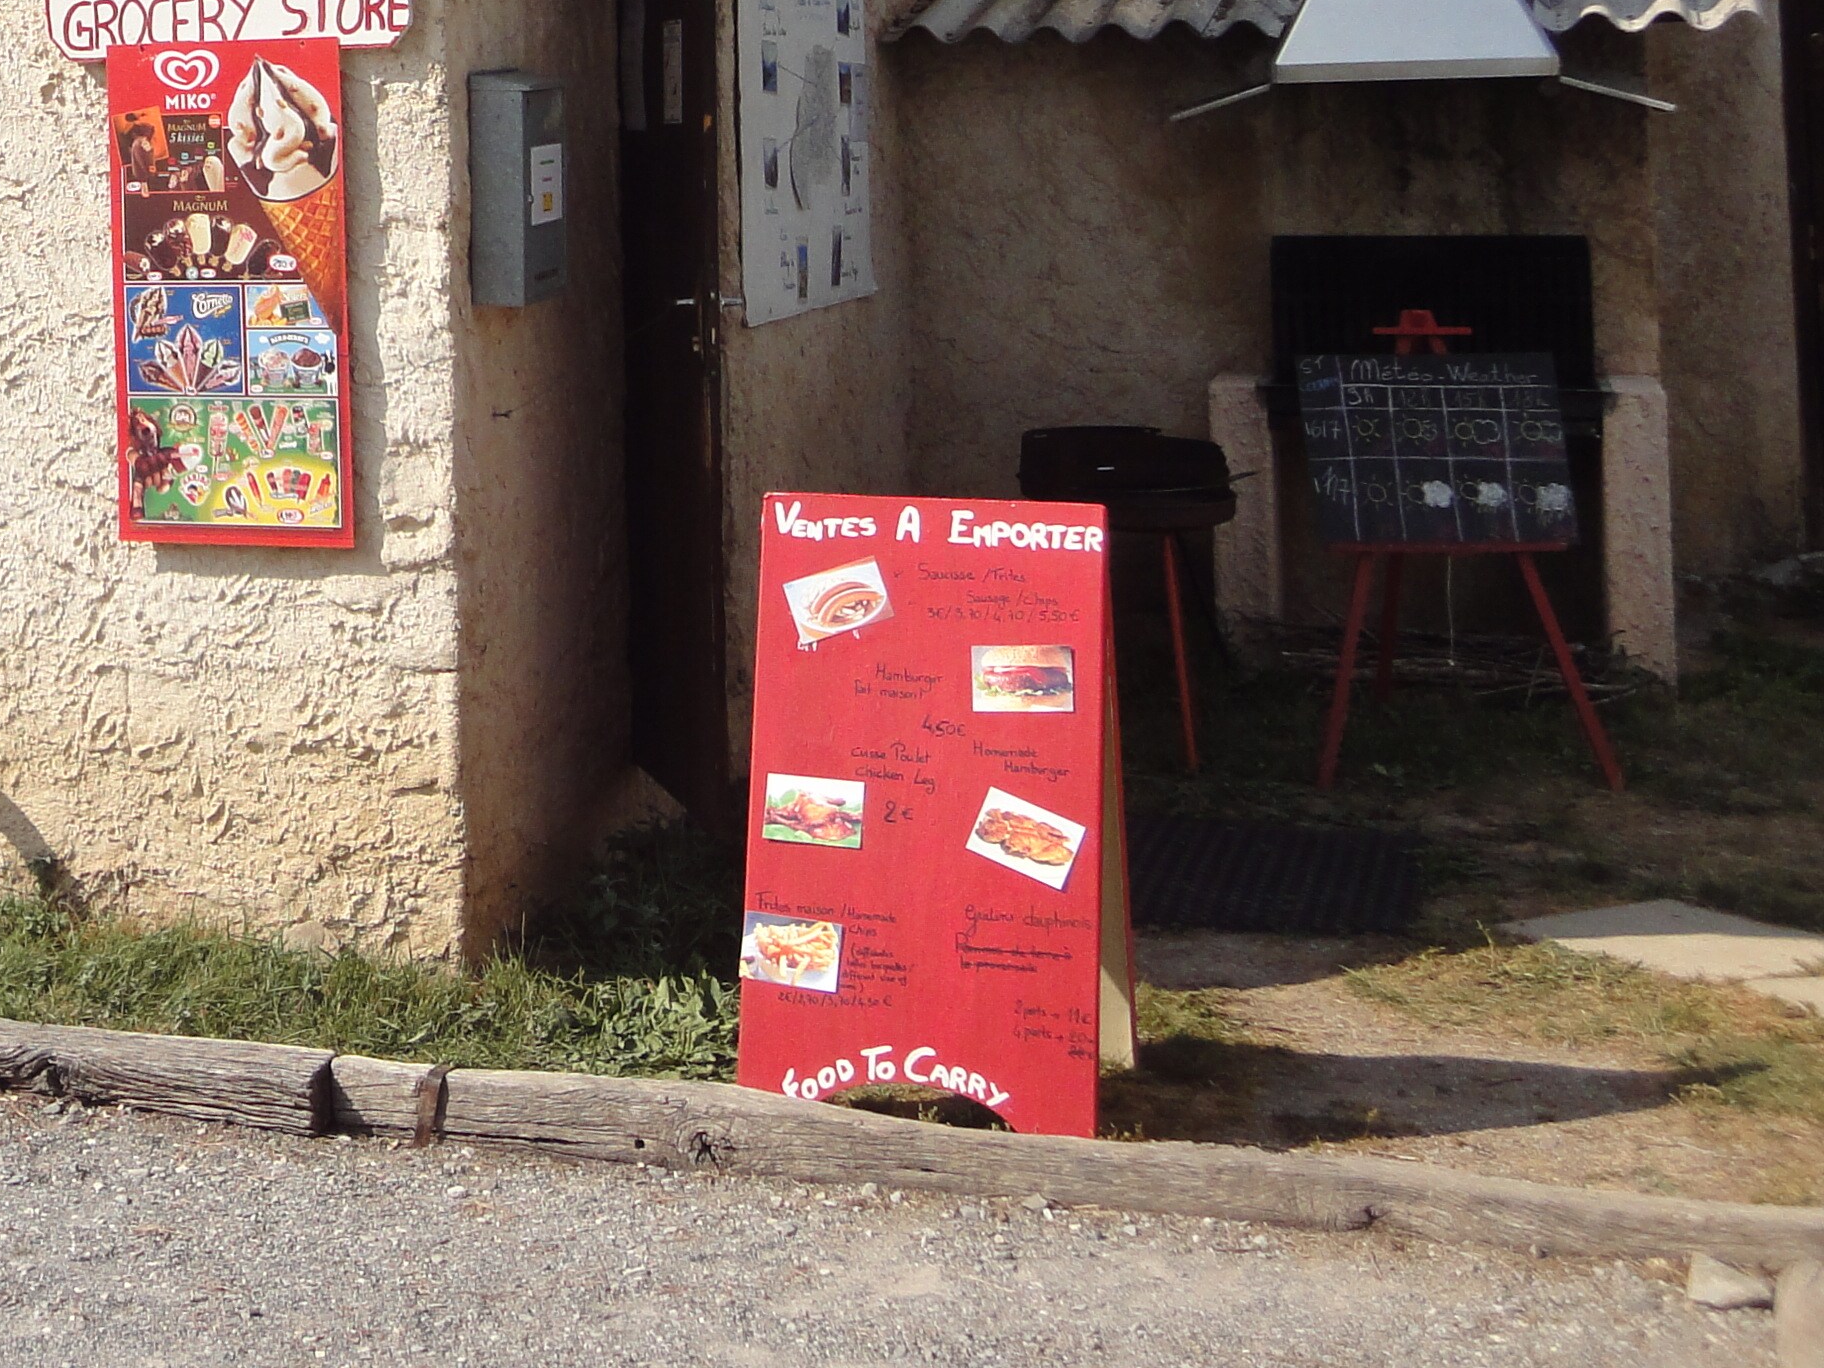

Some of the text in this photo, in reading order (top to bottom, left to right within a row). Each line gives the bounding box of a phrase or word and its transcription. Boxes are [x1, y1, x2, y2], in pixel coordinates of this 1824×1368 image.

[165, 94, 211, 110] MIKO
[167, 122, 206, 132] MAGNUM
[173, 200, 228, 212] MAGNUM
[1446, 362, 1538, 384] Weather
[775, 501, 1104, 551] VENTES A EMPORTER
[876, 664, 943, 693] Hamburger
[781, 1058, 854, 1100] FOOD
[904, 1047, 1011, 1107] CARRY
